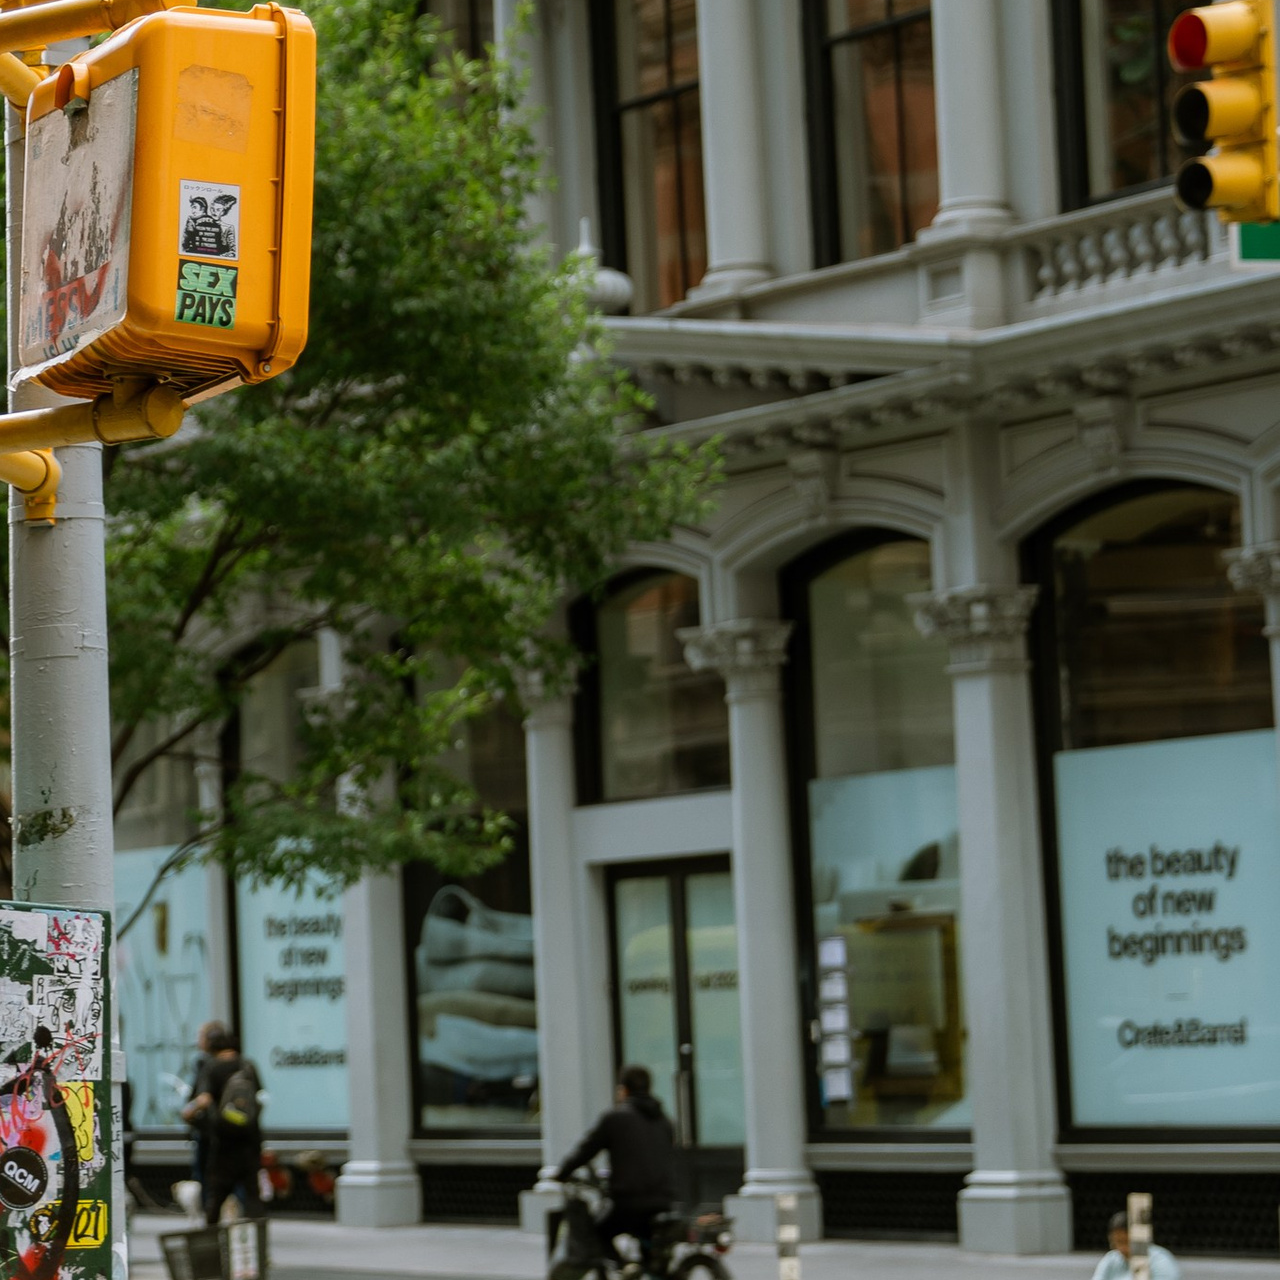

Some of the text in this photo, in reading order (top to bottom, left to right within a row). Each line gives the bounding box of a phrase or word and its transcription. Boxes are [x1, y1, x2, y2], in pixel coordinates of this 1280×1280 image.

[180, 262, 238, 297] SEX
[178, 292, 234, 327] PAYS
[1106, 841, 1240, 881] the beauty
[1132, 884, 1215, 918] of new
[1107, 921, 1247, 967] beginnings
[1118, 1017, 1248, 1049] Crate&Barrel
[3, 1160, 40, 1193] QCM
